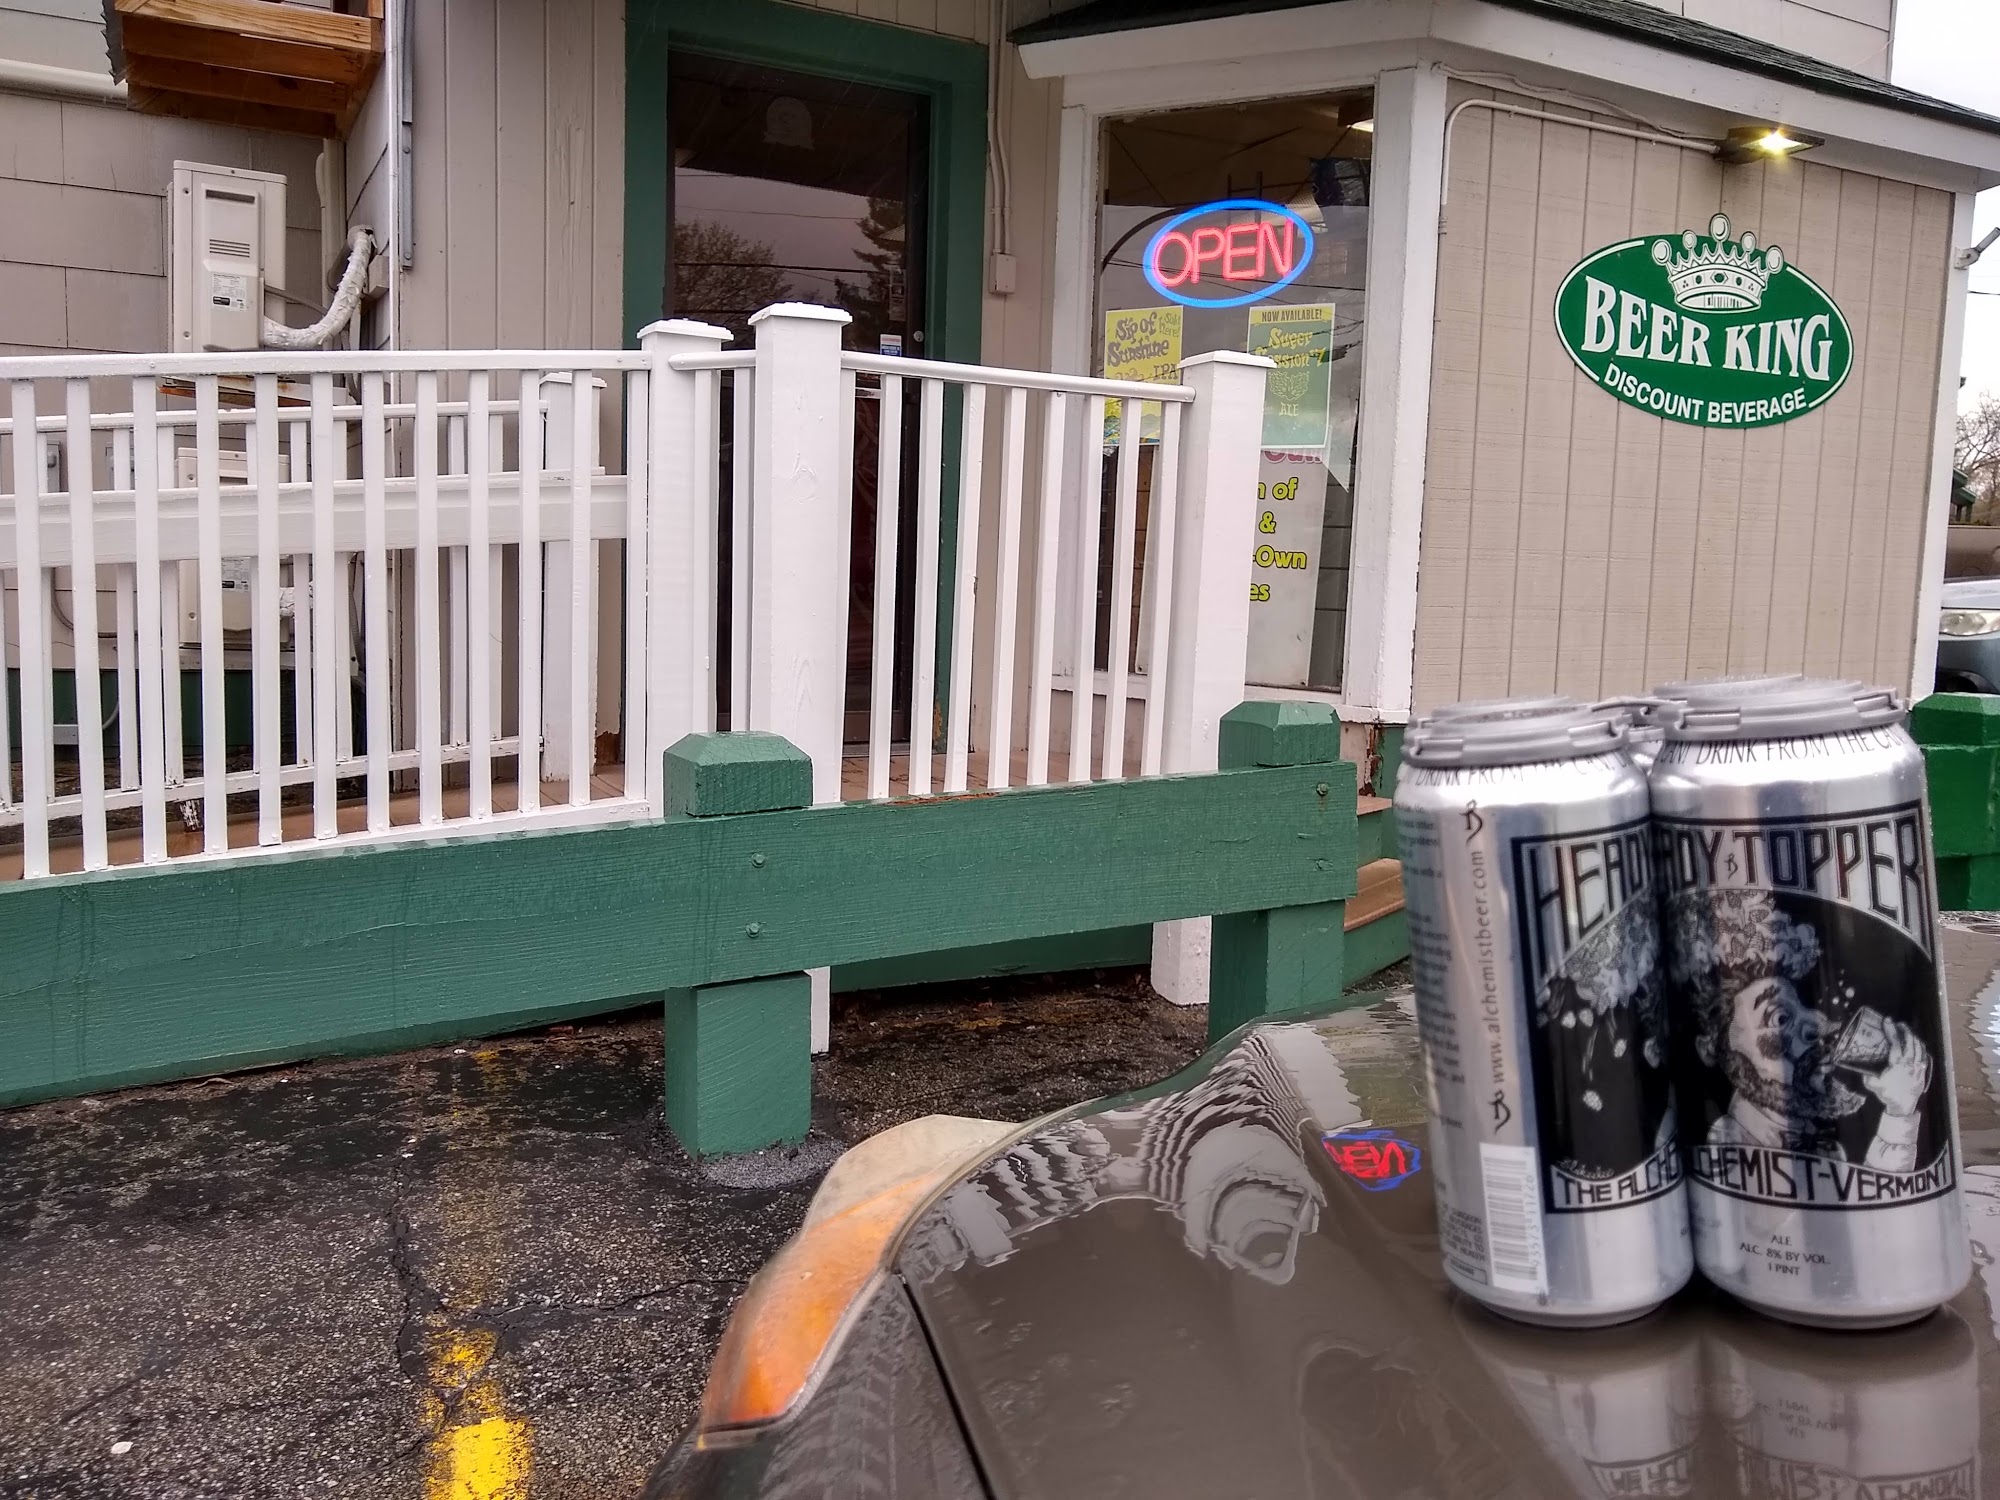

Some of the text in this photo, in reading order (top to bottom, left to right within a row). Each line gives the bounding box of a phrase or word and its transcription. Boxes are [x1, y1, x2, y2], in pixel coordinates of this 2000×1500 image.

[1153, 217, 1295, 288] OPEN
[1262, 309, 1322, 322] NOW AVAILABLE!
[1116, 318, 1138, 344] Sip
[1269, 328, 1313, 349] Super
[1581, 275, 1833, 381] BEER KING
[1107, 336, 1169, 367] Sunshine
[1153, 363, 1178, 380] IPA
[1604, 363, 1808, 423] DISCOUNT BEVERAGE
[1279, 402, 1299, 417] ALE
[1272, 477, 1298, 500] of
[1259, 511, 1276, 533] &
[1733, 815, 1928, 956] TOPPER
[1472, 851, 1504, 1084] www.alchemistbeer.com
[1556, 1171, 1612, 1205] THE
[1771, 1235, 1792, 1246] ALE
[1766, 1248, 1782, 1259] 8%
[1786, 1251, 1799, 1261] BY
[1775, 1264, 1799, 1275] PINT
